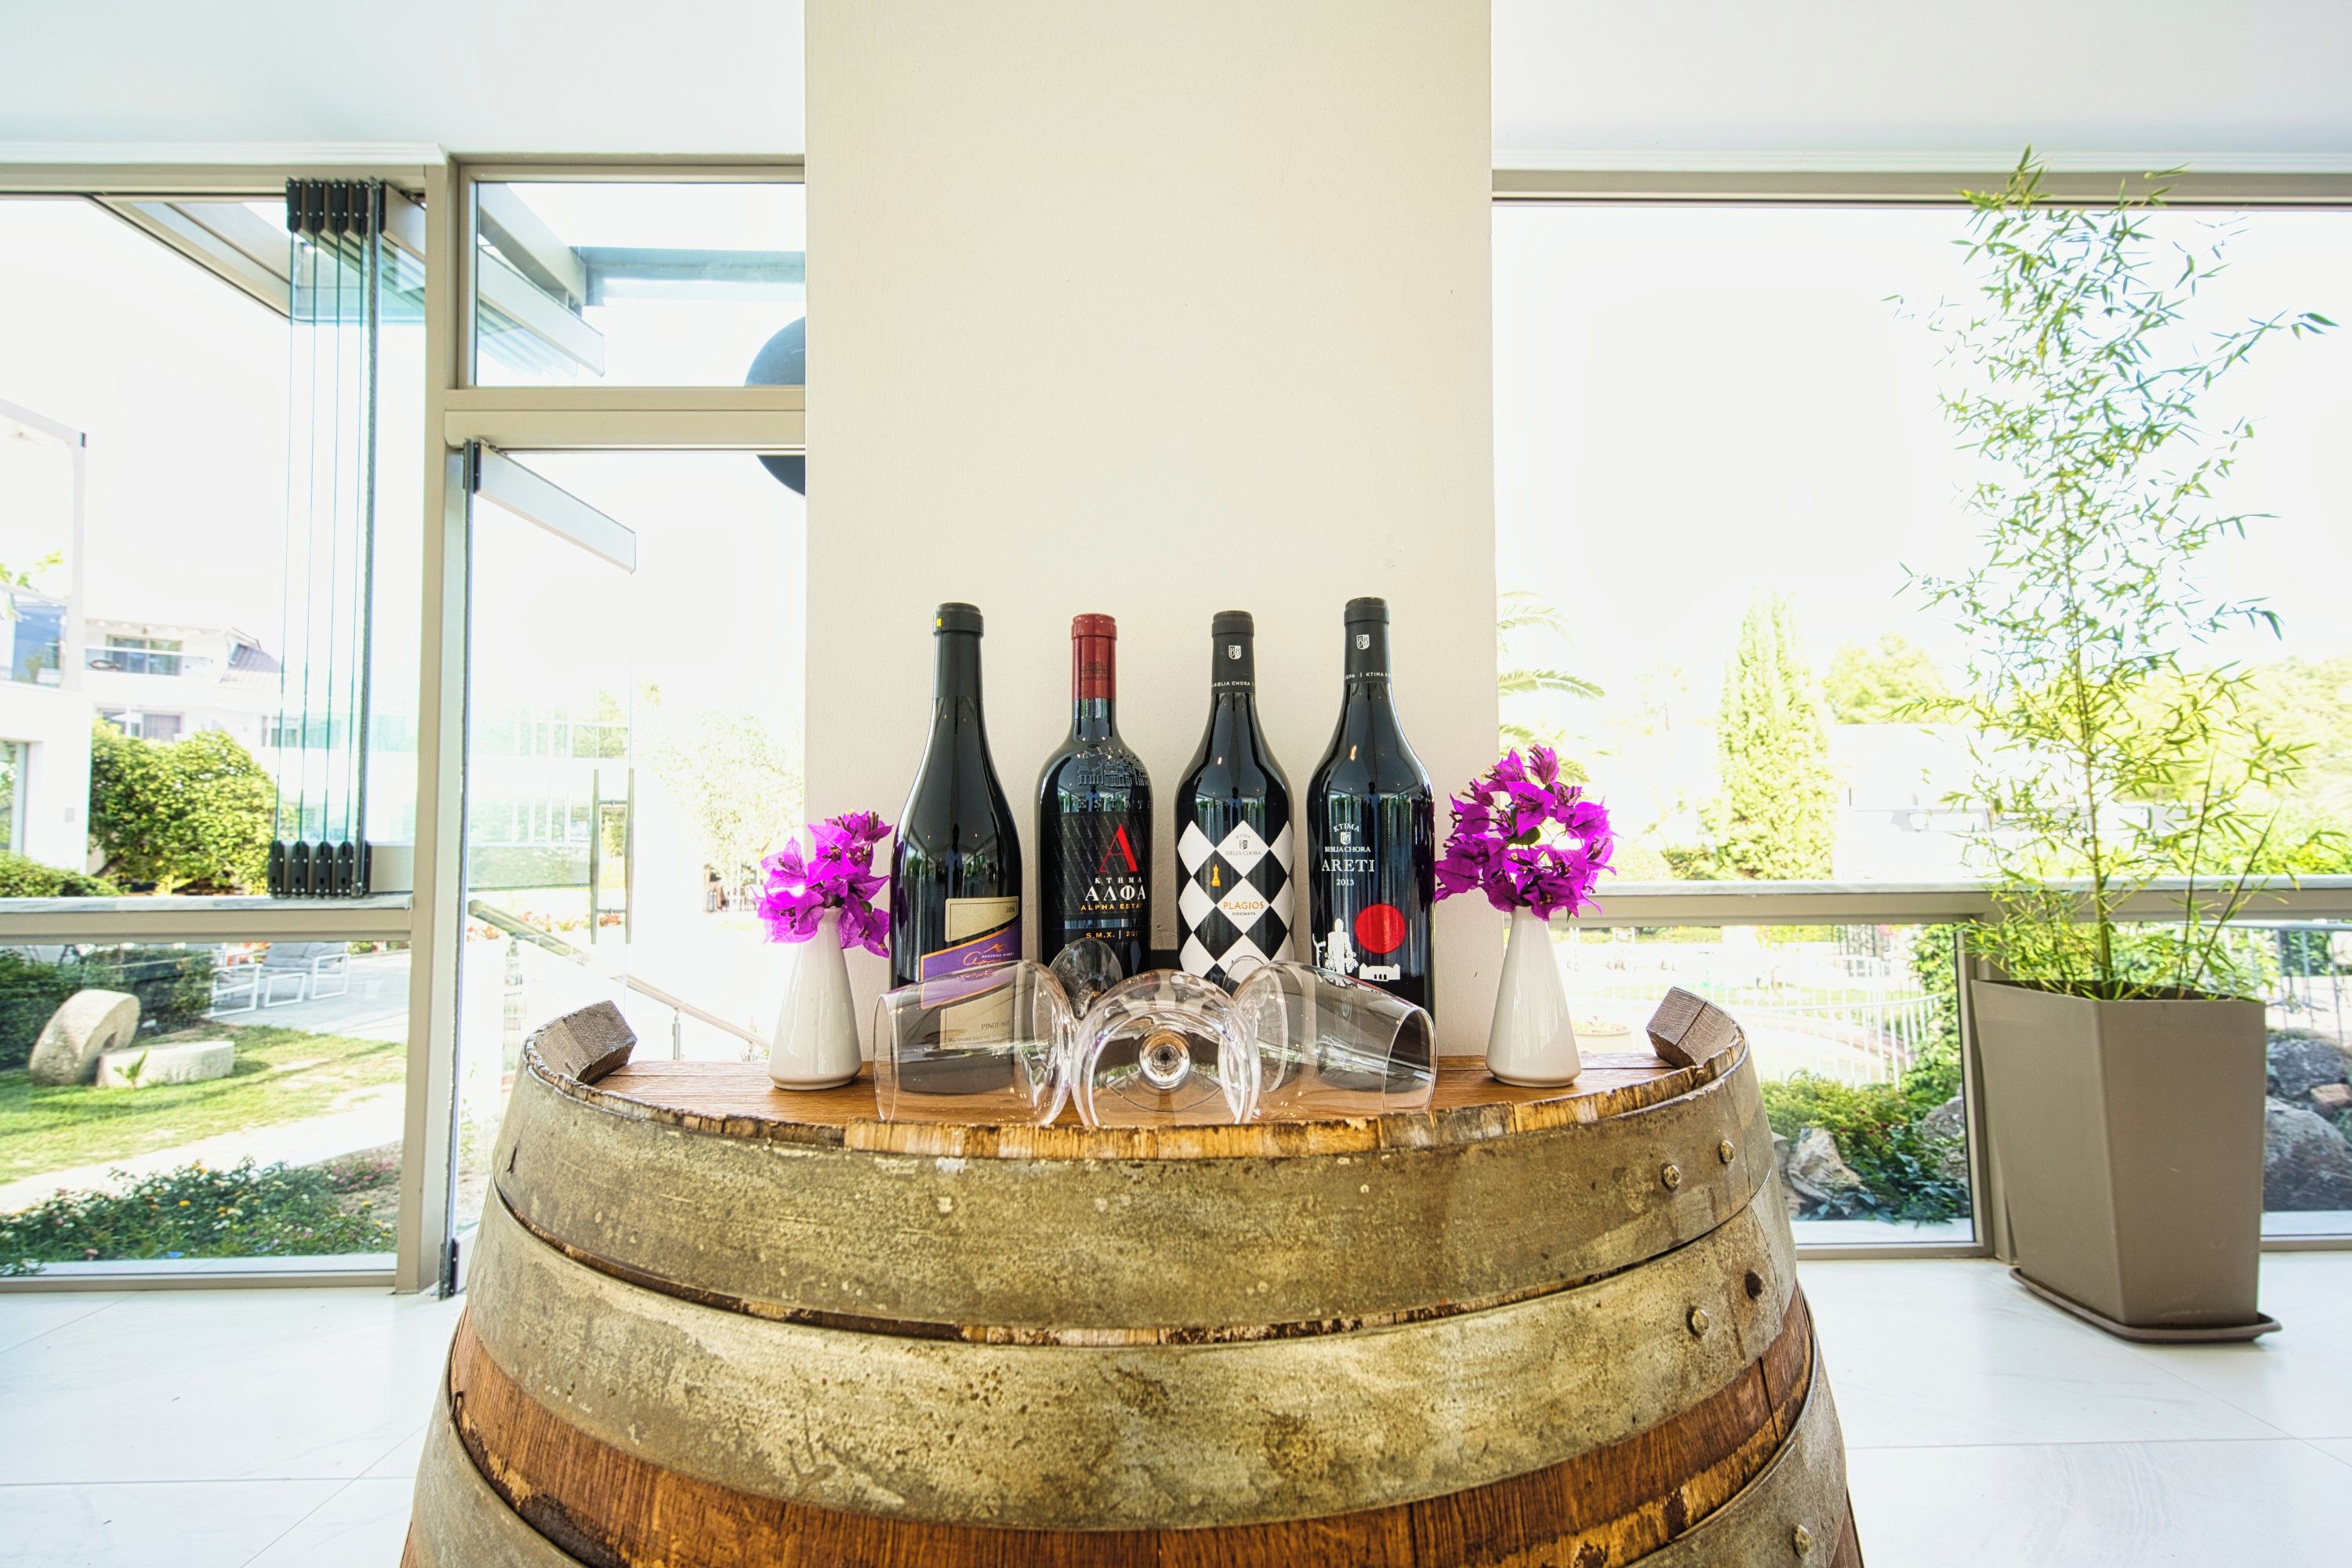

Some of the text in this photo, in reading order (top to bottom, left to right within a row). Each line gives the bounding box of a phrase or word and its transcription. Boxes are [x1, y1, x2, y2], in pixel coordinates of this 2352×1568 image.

[1333, 822, 1360, 833] KTIMA
[1321, 858, 1375, 873] ARETI
[1223, 901, 1264, 909] PLAGIOS
[981, 1022, 999, 1030] PINOT
